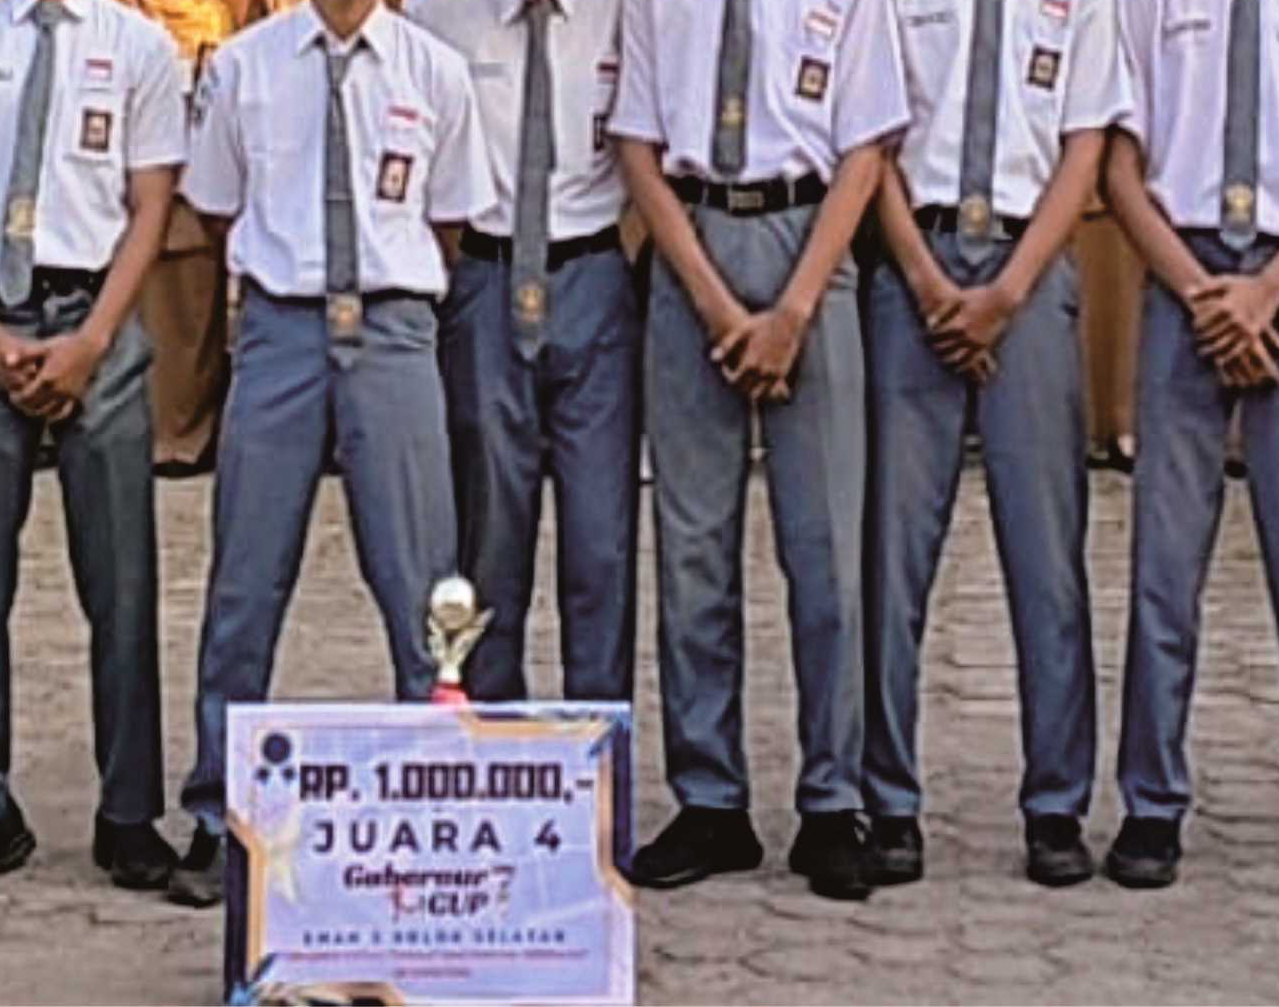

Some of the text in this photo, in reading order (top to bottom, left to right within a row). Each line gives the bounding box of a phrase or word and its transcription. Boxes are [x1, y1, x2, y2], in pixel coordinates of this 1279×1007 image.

[299, 763, 594, 802] RP. 1.000.000,-
[312, 819, 561, 854] JUARA 4
[343, 863, 489, 889] Gubernur
[427, 892, 490, 917] CUP
